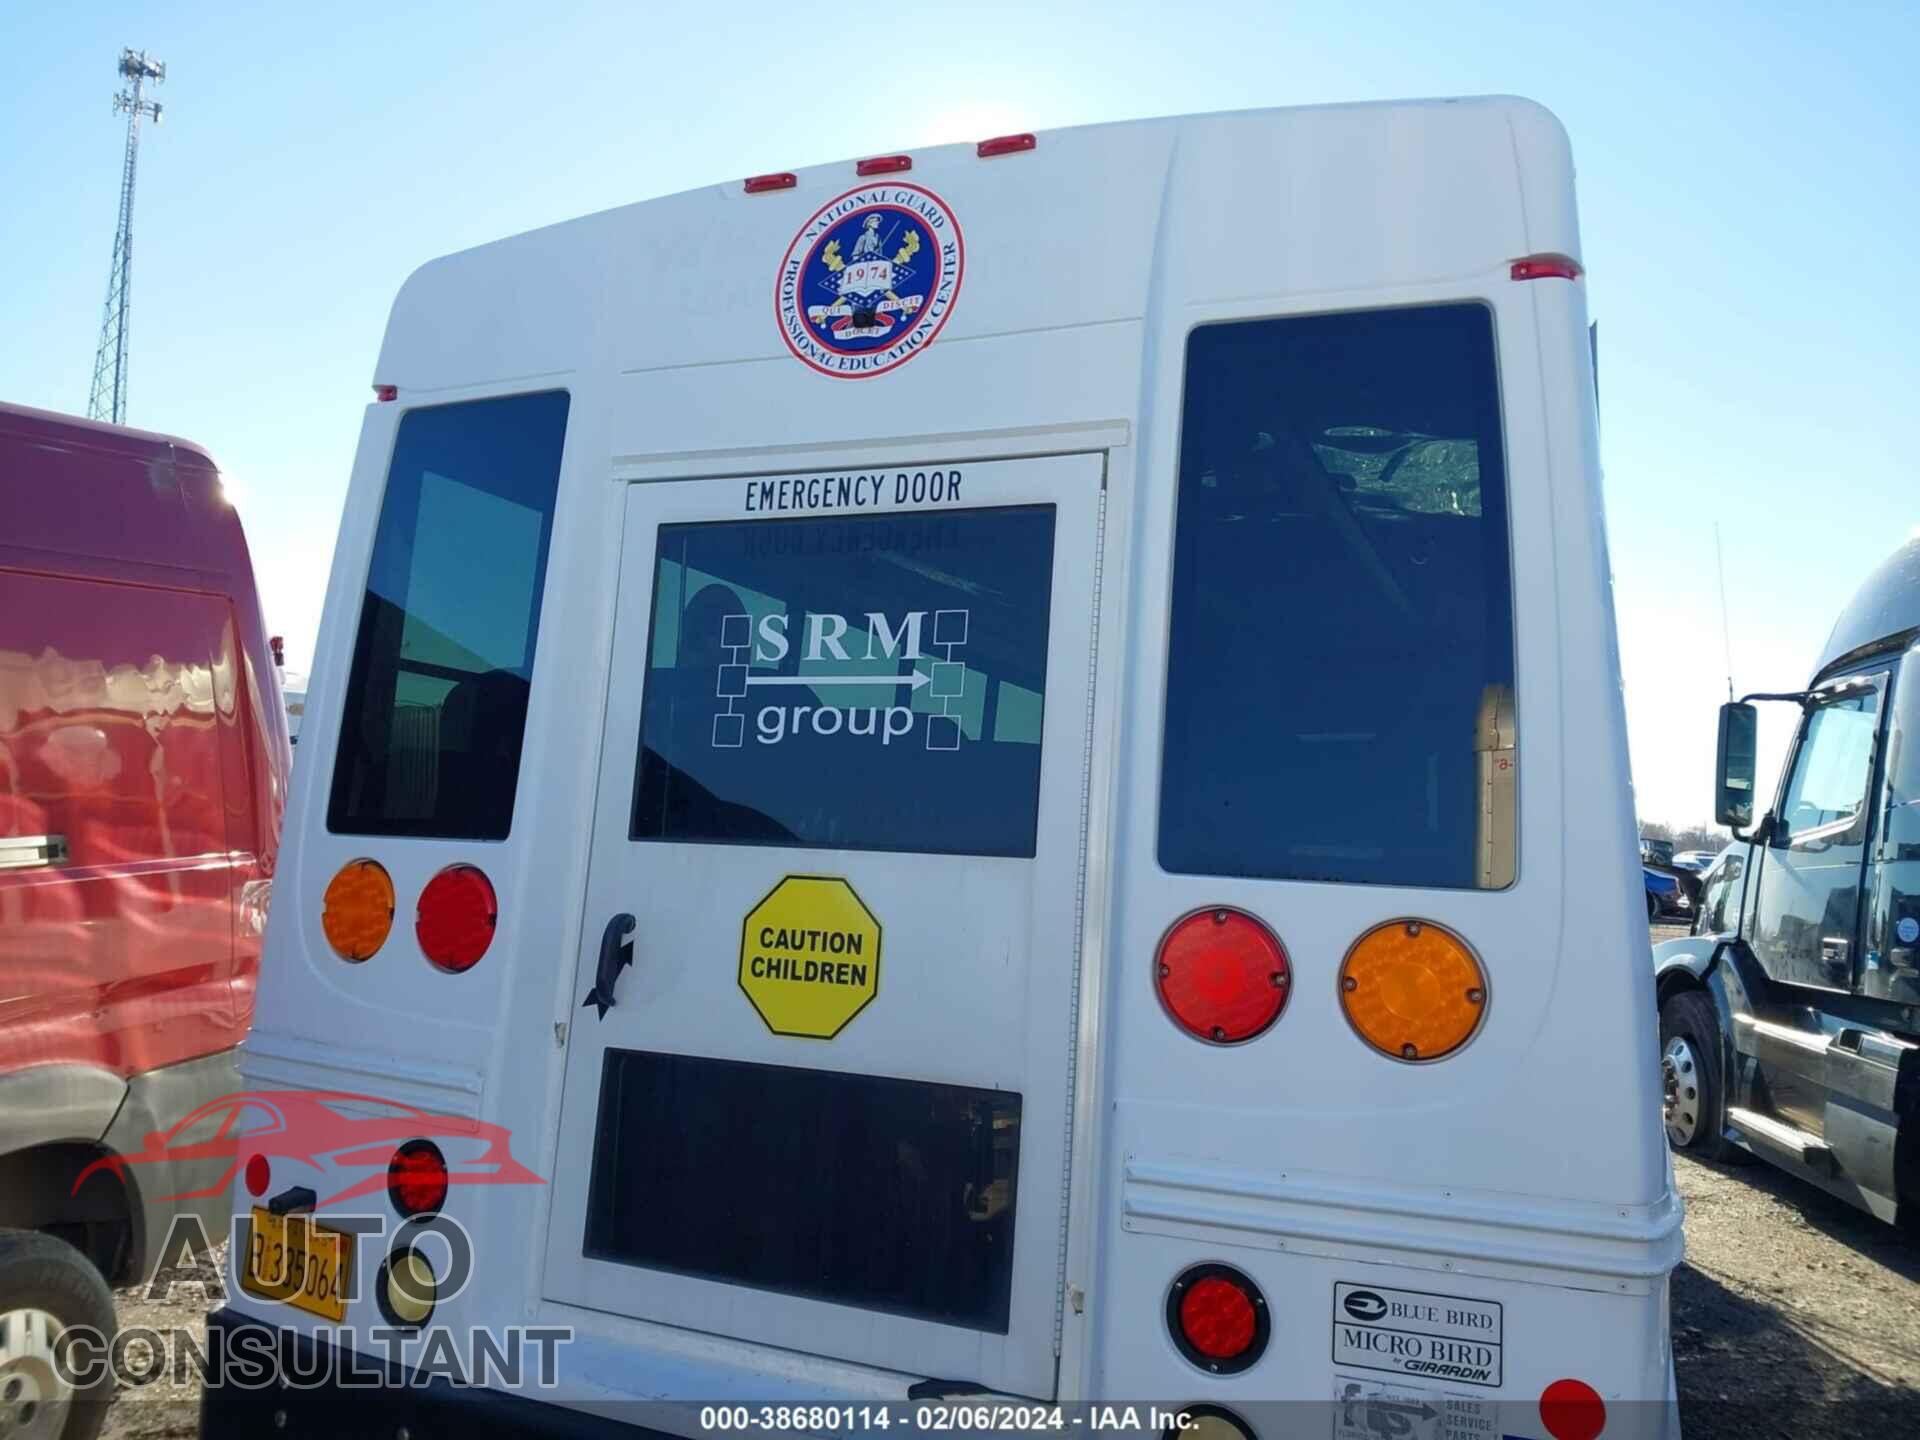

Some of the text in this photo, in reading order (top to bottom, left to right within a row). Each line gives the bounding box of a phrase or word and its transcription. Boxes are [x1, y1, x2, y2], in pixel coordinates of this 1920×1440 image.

[806, 190, 944, 241] NATIONAL GUARD
[846, 266, 888, 285] 1974
[782, 240, 956, 371] PROFESSIONAL EDUCATION CENTER
[745, 471, 962, 511] EMERGENCY DOOR
[756, 611, 929, 662] SRM
[756, 705, 914, 745] group
[759, 927, 863, 955] CAUTION
[750, 956, 868, 987] CHILDREN
[1391, 1302, 1493, 1330] BLUE BIRD
[1343, 1328, 1492, 1367] MICRO BIRD
[1404, 1359, 1491, 1381] GIRARDIN
[1446, 1400, 1481, 1415] SALES
[1446, 1414, 1493, 1432] SERVICE
